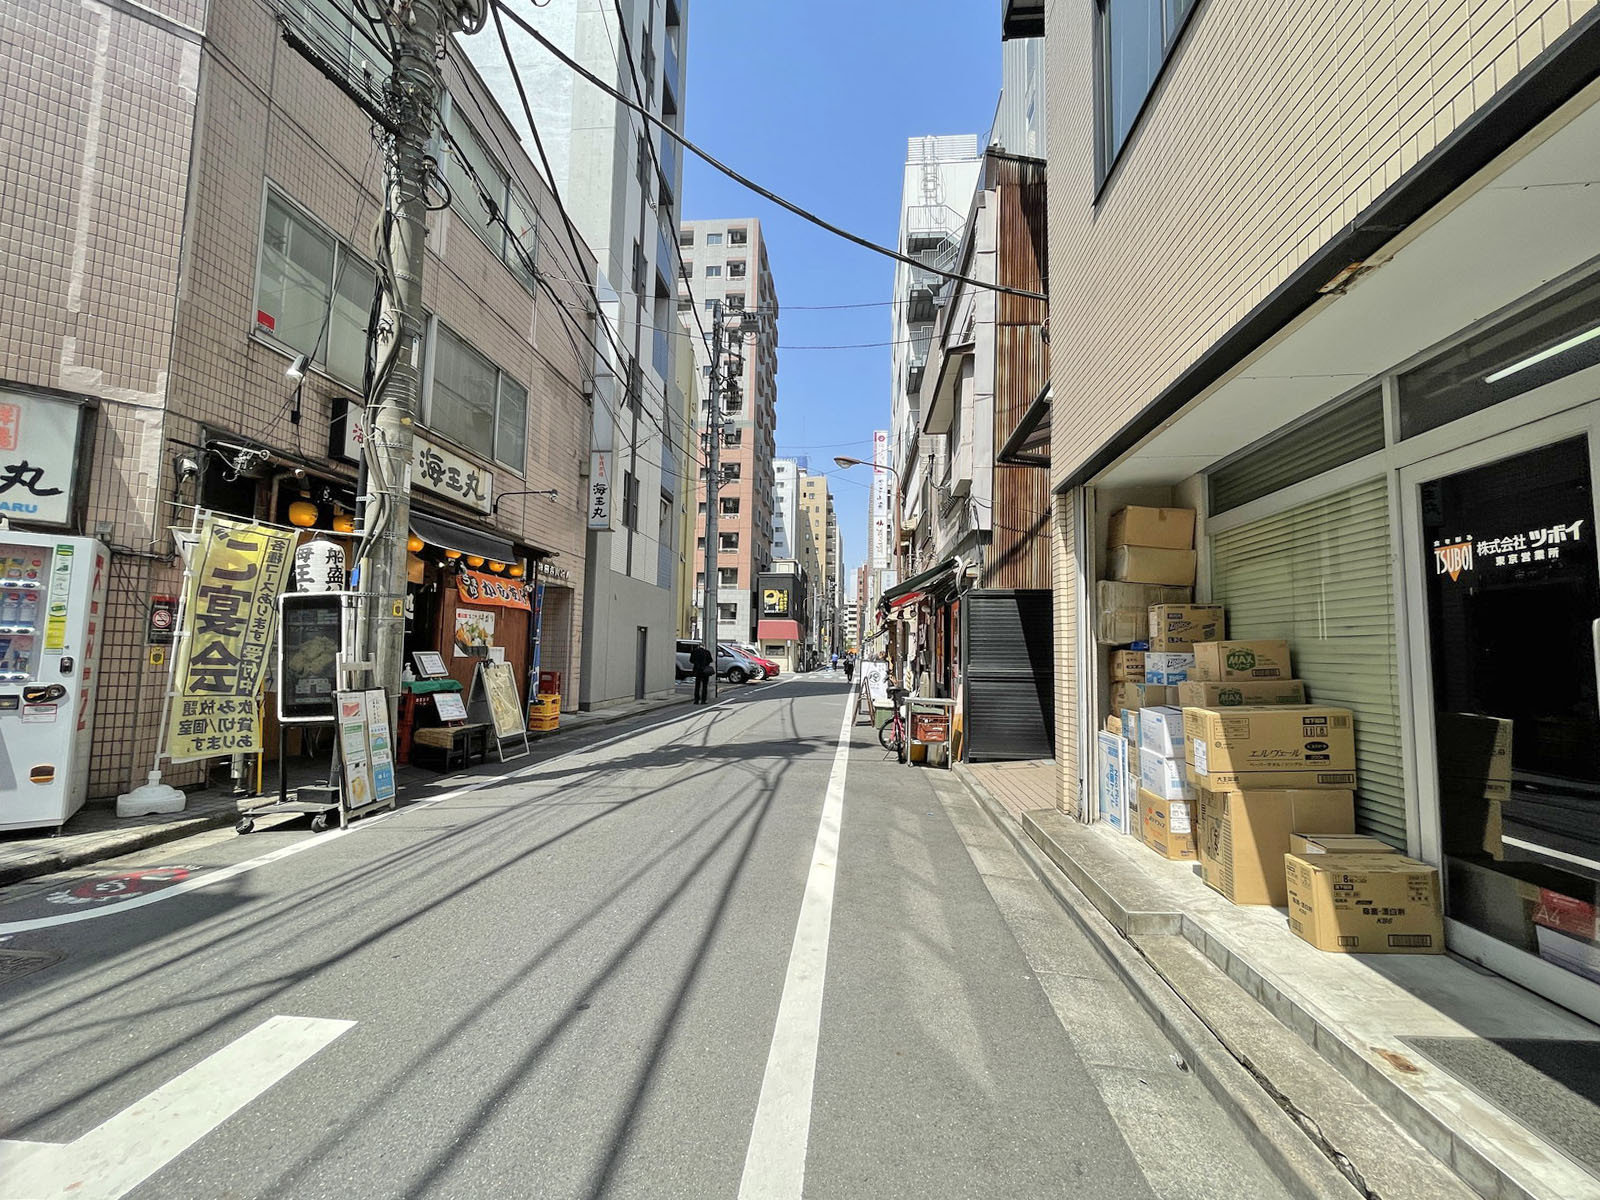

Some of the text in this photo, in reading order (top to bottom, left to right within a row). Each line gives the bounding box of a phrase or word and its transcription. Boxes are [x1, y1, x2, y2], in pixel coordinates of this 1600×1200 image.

[0, 459, 65, 497] 丸
[419, 447, 486, 502] 海王丸
[591, 483, 608, 519] 海王丸
[1434, 544, 1474, 575] TSUBOI
[1495, 547, 1560, 566] 東京営業所
[1228, 654, 1255, 665] MAX
[1248, 749, 1302, 758] エルヴェール
[1536, 903, 1561, 927] A4
